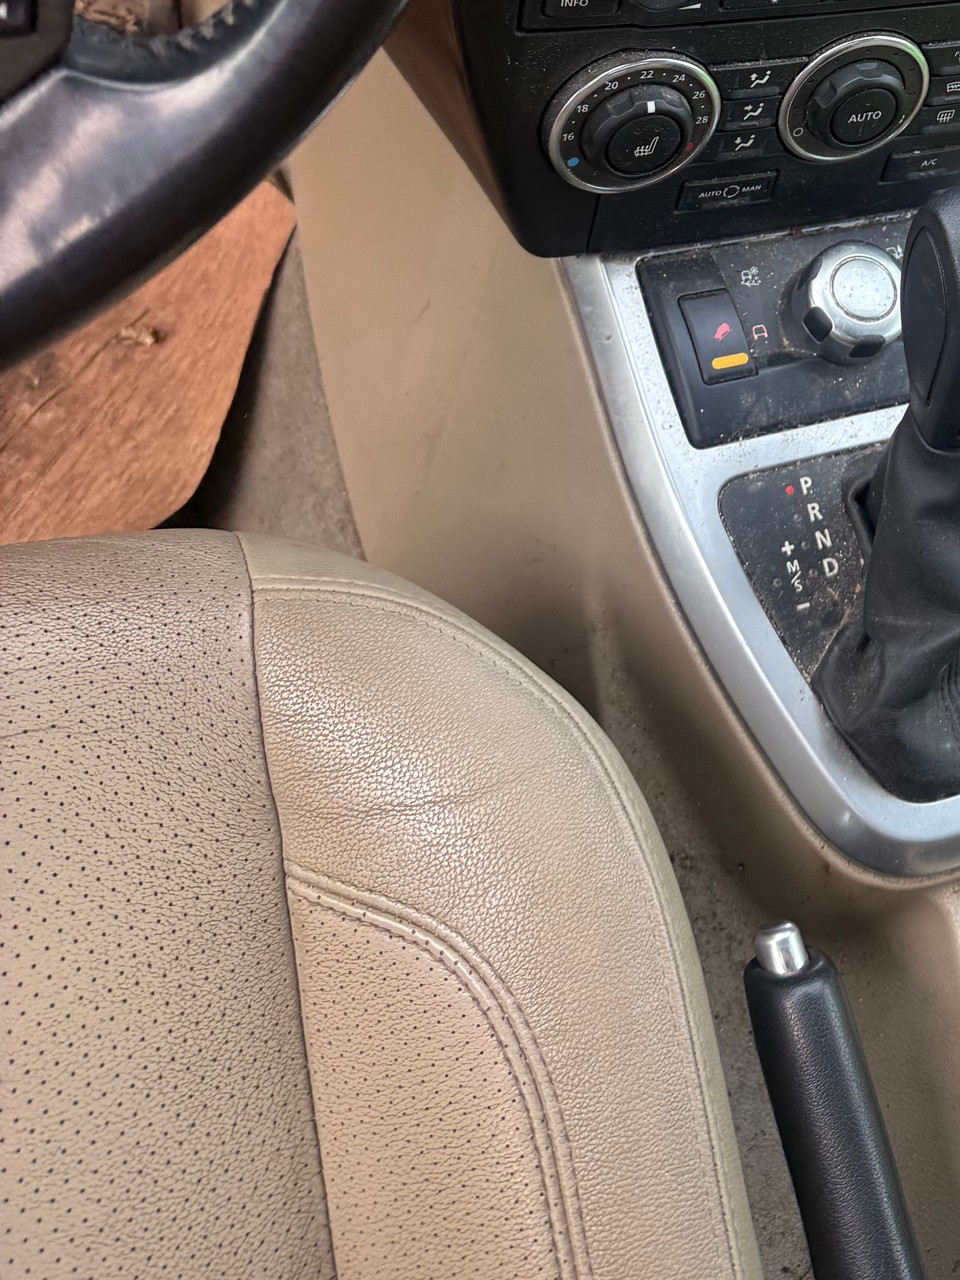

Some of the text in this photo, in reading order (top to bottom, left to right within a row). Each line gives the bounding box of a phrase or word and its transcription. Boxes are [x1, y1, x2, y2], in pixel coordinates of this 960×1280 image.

[640, 70, 654, 80] 22
[672, 73, 686, 83] 24
[604, 80, 619, 91] 20
[692, 90, 706, 100] 26
[576, 104, 589, 114] 18
[695, 116, 709, 125] 28
[847, 110, 882, 124] AUTO
[562, 132, 575, 142] 16
[921, 158, 938, 167] A/C
[698, 184, 762, 199] AUTO MAN
[800, 477, 812, 496] P
[807, 503, 823, 522] R
[815, 528, 833, 550] N
[822, 557, 839, 577] D
